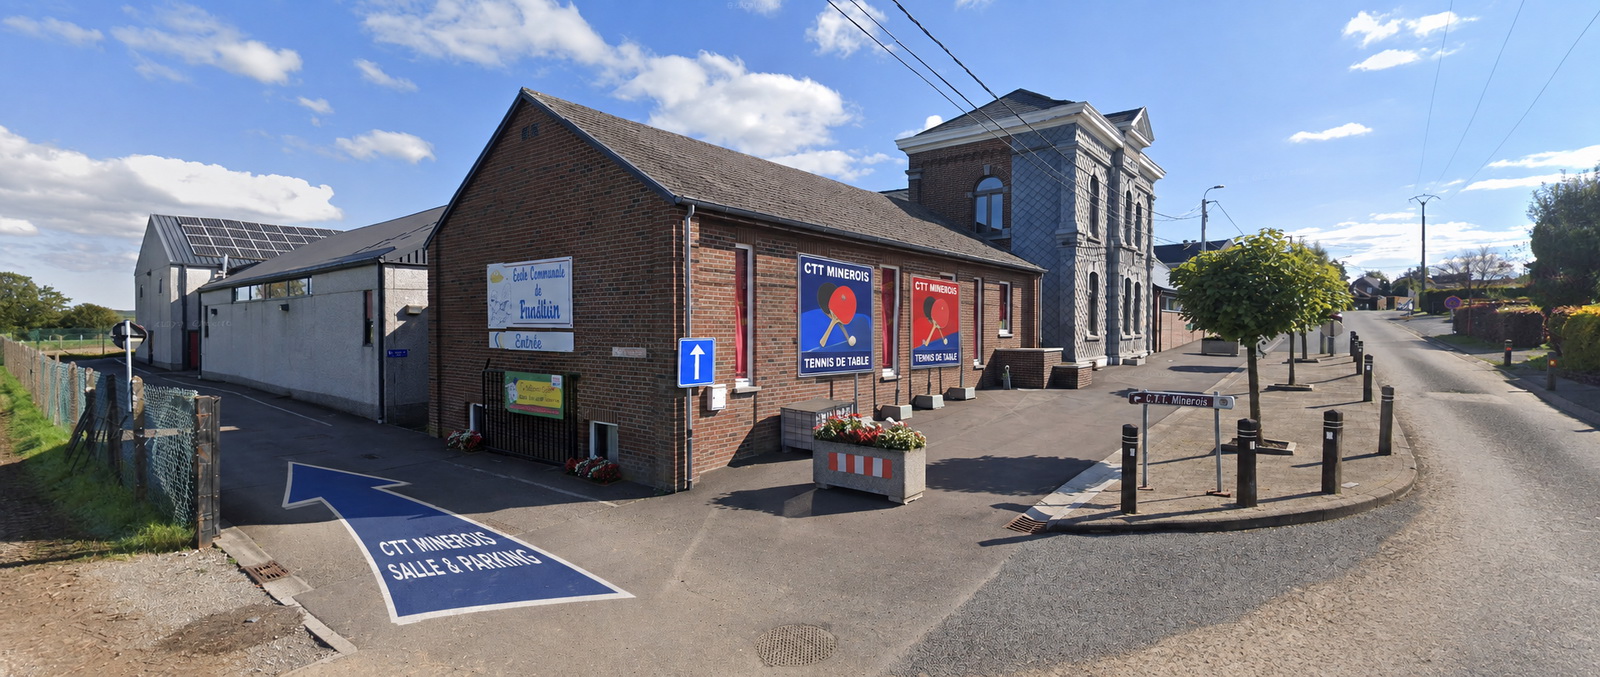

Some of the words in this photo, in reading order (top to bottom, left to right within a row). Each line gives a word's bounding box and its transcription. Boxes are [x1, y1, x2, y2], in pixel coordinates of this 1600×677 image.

[804, 262, 824, 276] CTT
[826, 265, 870, 283] MINEROIS
[534, 283, 542, 297] de
[915, 281, 928, 291] CTT
[515, 333, 543, 349] Entrée
[804, 357, 834, 369] TENNIS
[836, 357, 846, 367] DE
[847, 355, 869, 366] TABLE
[935, 353, 942, 361] DE
[1146, 394, 1168, 404] C.T.T.
[379, 539, 414, 556] CTT
[412, 531, 497, 552] MINEROIS
[387, 558, 446, 581] SALLE
[442, 557, 464, 574] &
[456, 548, 542, 572] PARKING
